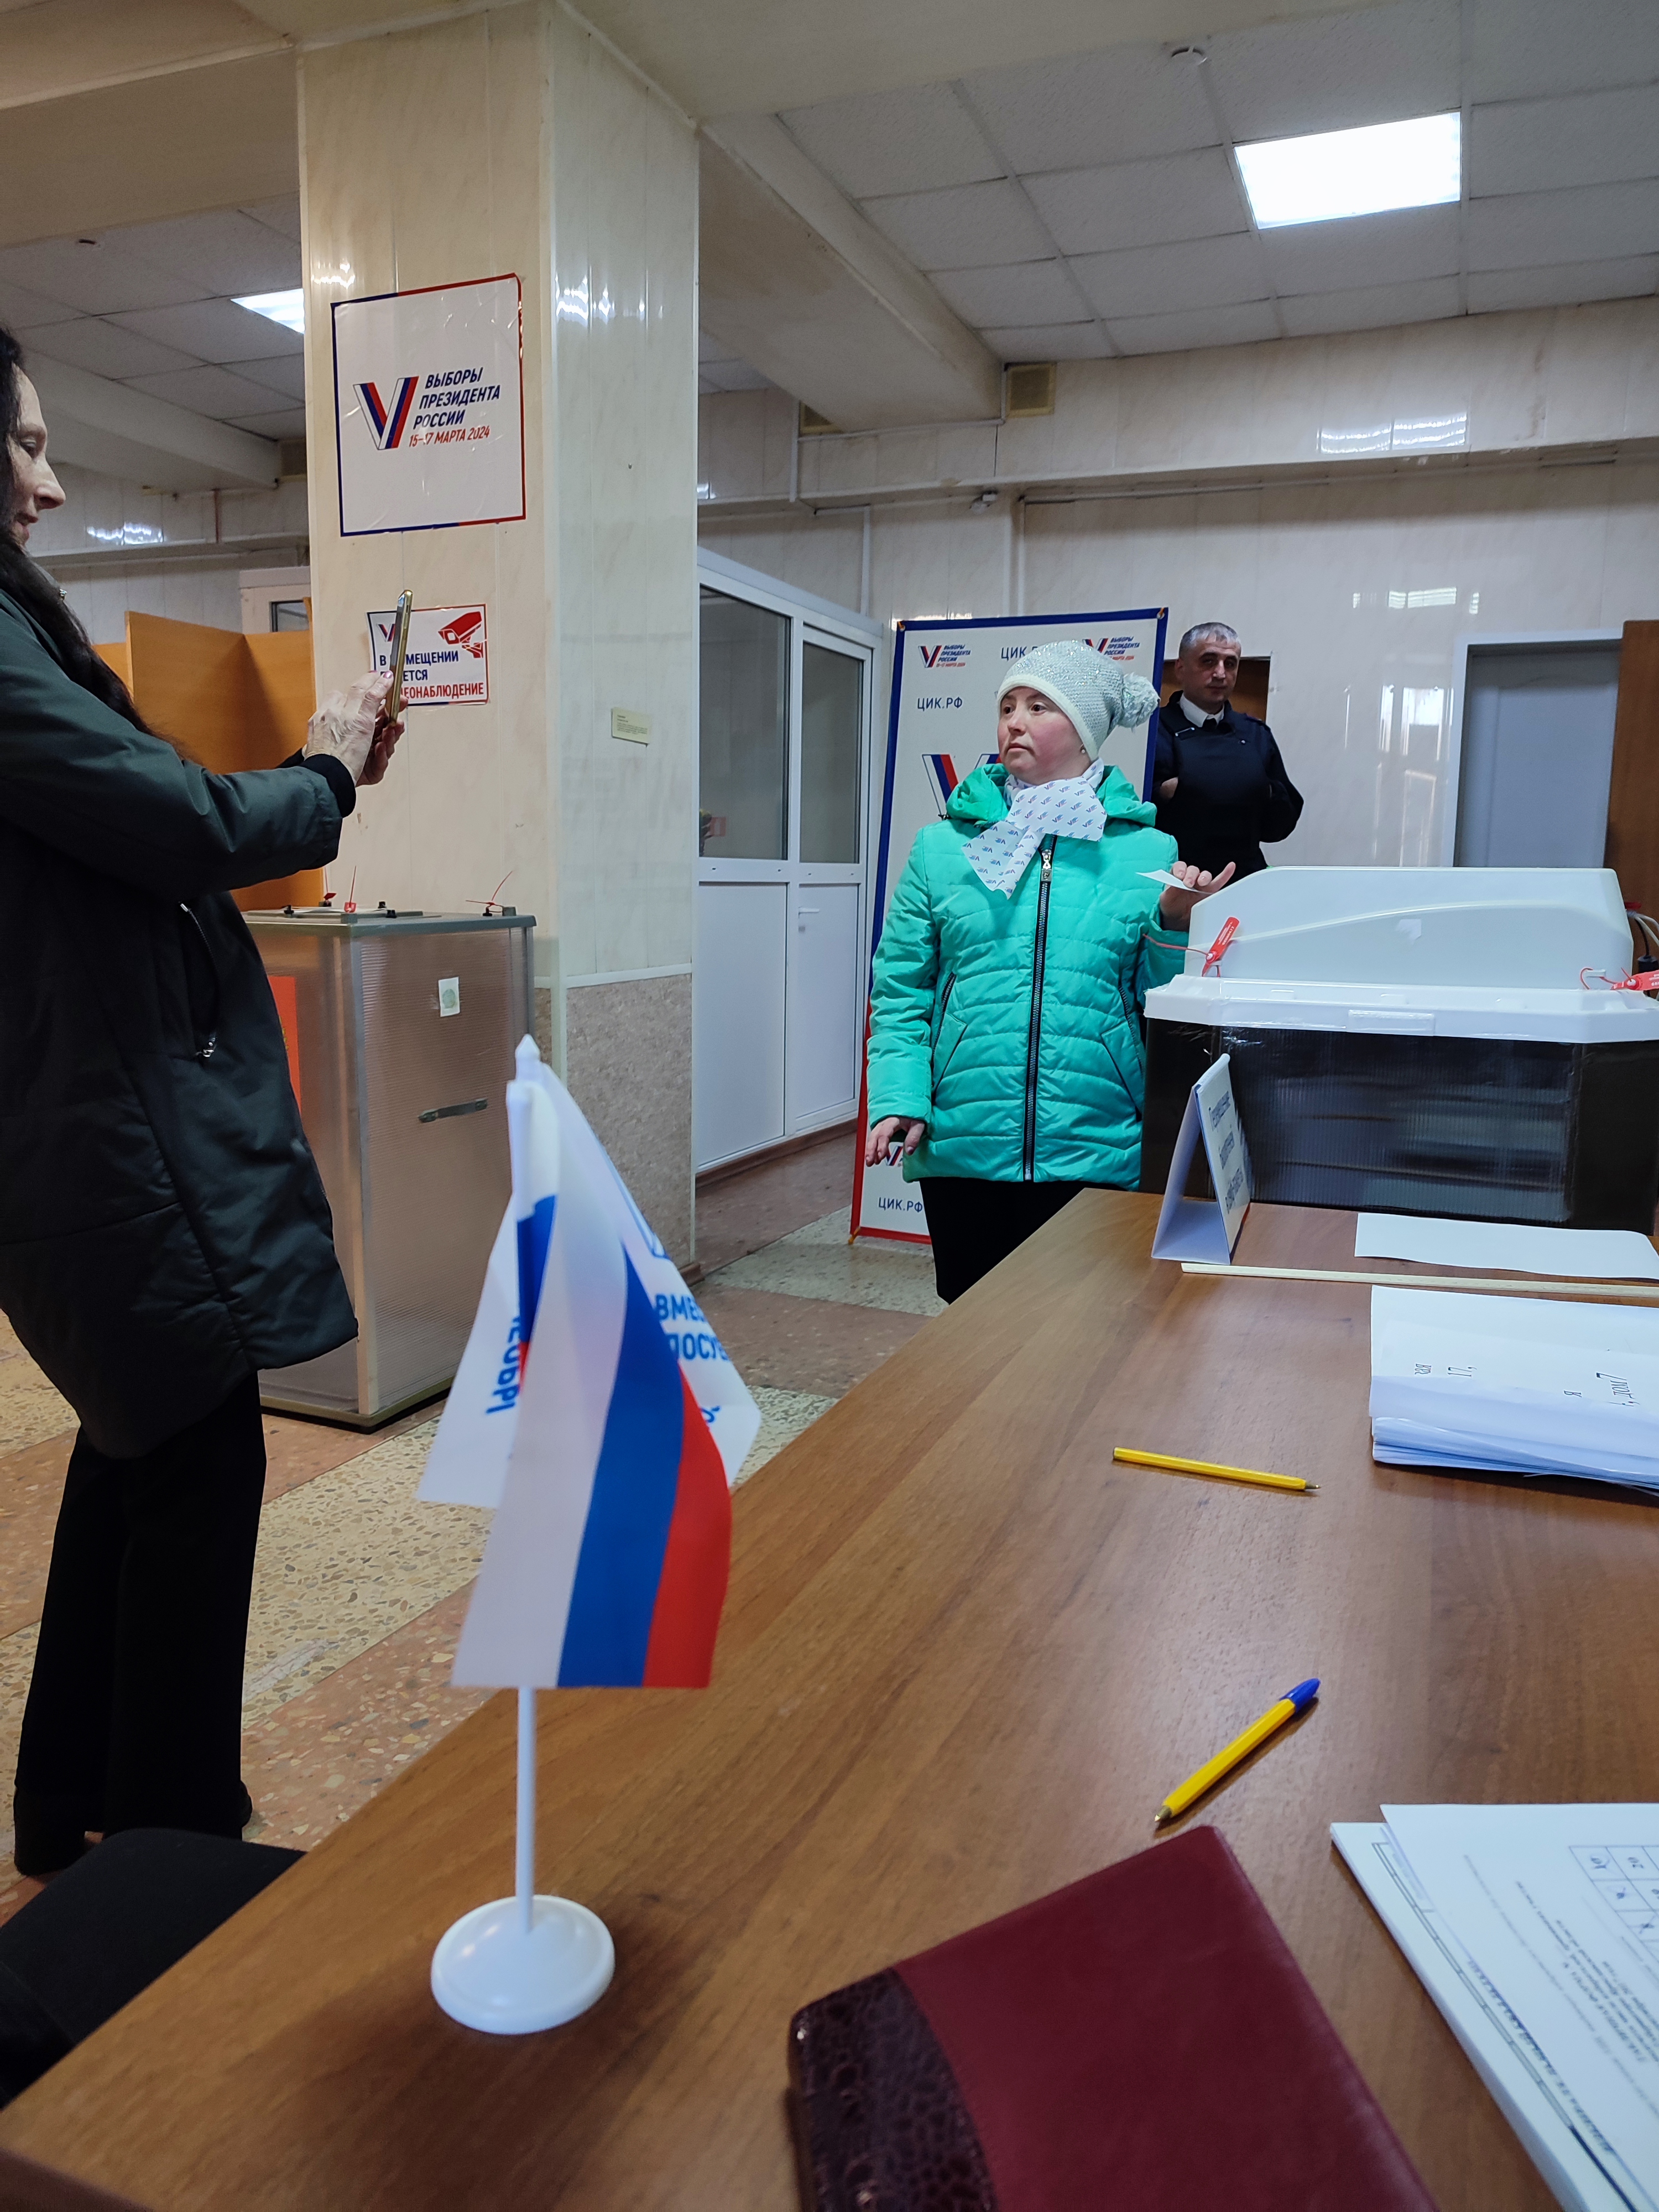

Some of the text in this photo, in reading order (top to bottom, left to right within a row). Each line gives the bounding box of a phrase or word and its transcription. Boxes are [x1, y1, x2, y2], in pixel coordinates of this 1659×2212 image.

[425, 367, 483, 389] ВЫБОРЫ
[419, 385, 500, 410] ПРЕЗИДЕНТА
[413, 409, 466, 430] РОССИИ
[434, 429, 466, 444] МАРТА
[467, 425, 490, 441] 2024
[380, 650, 458, 666] В МЕЩЕНИИ
[400, 682, 484, 700] ЕОНАБЛЮДЕНИЕ
[917, 697, 963, 712] ЦИК.РФ
[878, 1197, 924, 1213] ЦИК.РФ
